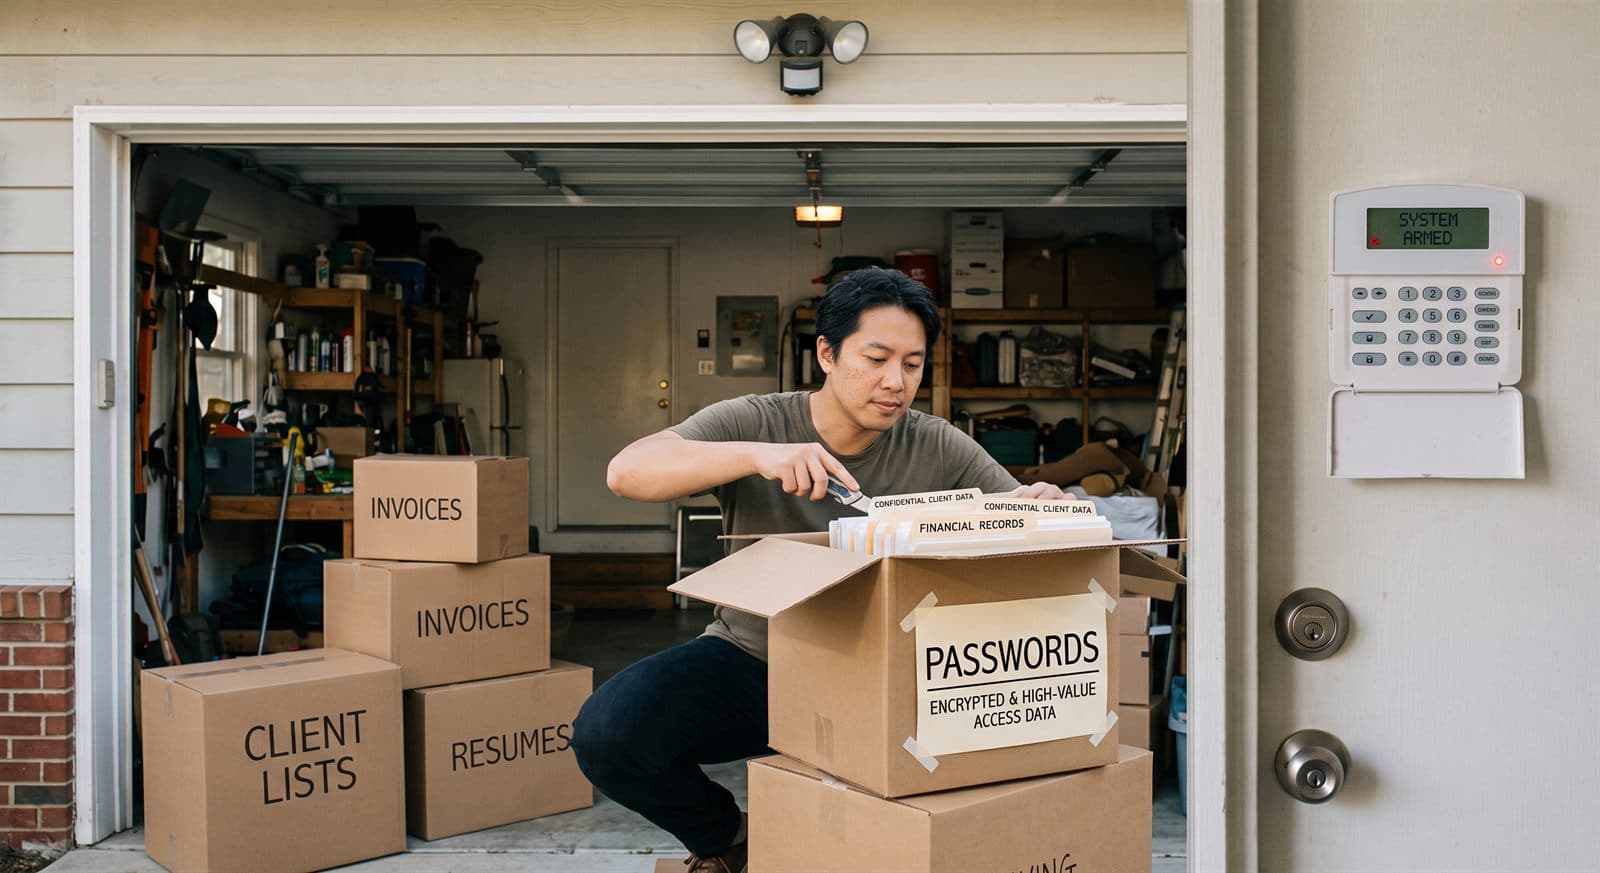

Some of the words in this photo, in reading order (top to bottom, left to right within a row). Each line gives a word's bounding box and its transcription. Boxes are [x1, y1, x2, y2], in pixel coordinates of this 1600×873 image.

[1399, 212, 1459, 227] SYSTEM
[1403, 231, 1453, 245] ARMED
[1430, 290, 1436, 298] 2
[1454, 290, 1461, 298] 3
[1405, 312, 1411, 320] 4
[1430, 312, 1436, 320] 5
[1454, 312, 1461, 320] 6
[1405, 333, 1411, 342] 7
[1430, 333, 1436, 342] 8
[1454, 333, 1460, 342] 9
[1430, 355, 1436, 363] 0
[371, 497, 462, 521] INVOICES
[874, 497, 925, 508] CONFIDENTIAL
[928, 495, 953, 503] CLIENT
[984, 502, 1040, 512] CONFIDENTIAL
[1042, 504, 1069, 513] CLIENT
[1071, 506, 1092, 514] DATA
[919, 521, 975, 533] FINANCIAL
[979, 518, 1025, 530] RECORDS
[417, 598, 529, 638] INVOICES
[926, 630, 1099, 681] PASSWORDS
[930, 692, 1005, 716] ENCRYPTED
[1009, 691, 1018, 706] &
[1022, 681, 1097, 704] HIGH-VALUE
[973, 710, 1022, 730] ACCESS
[1025, 705, 1057, 723] DATA
[244, 709, 367, 762] CLIENT
[452, 723, 571, 772] RESUMES
[262, 756, 357, 805] LISTS
